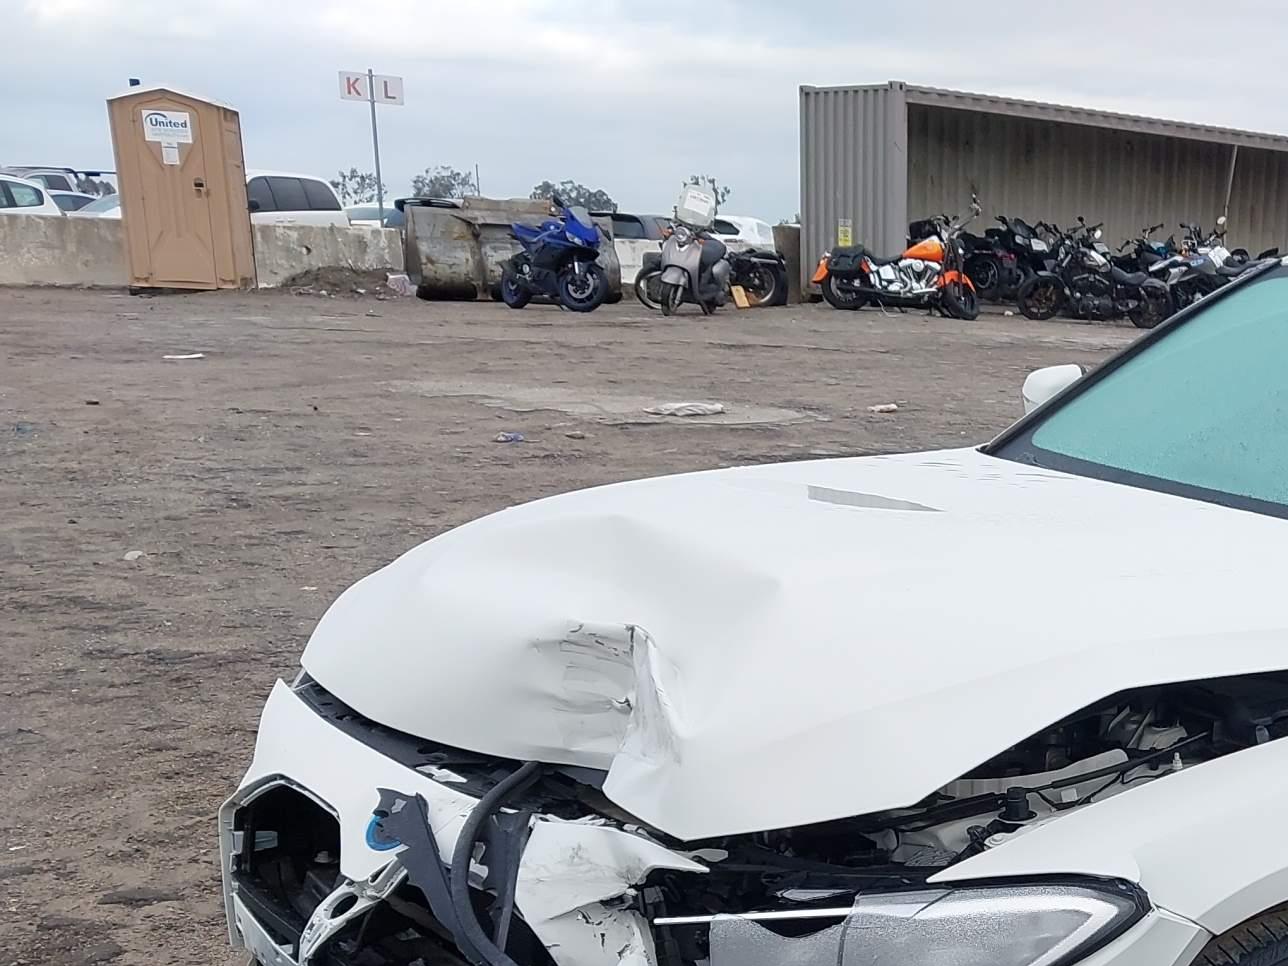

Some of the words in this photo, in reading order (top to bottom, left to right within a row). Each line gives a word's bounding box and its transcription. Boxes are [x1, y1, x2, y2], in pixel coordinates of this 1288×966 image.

[346, 76, 362, 97] K
[383, 80, 397, 100] L
[149, 117, 188, 129] United
